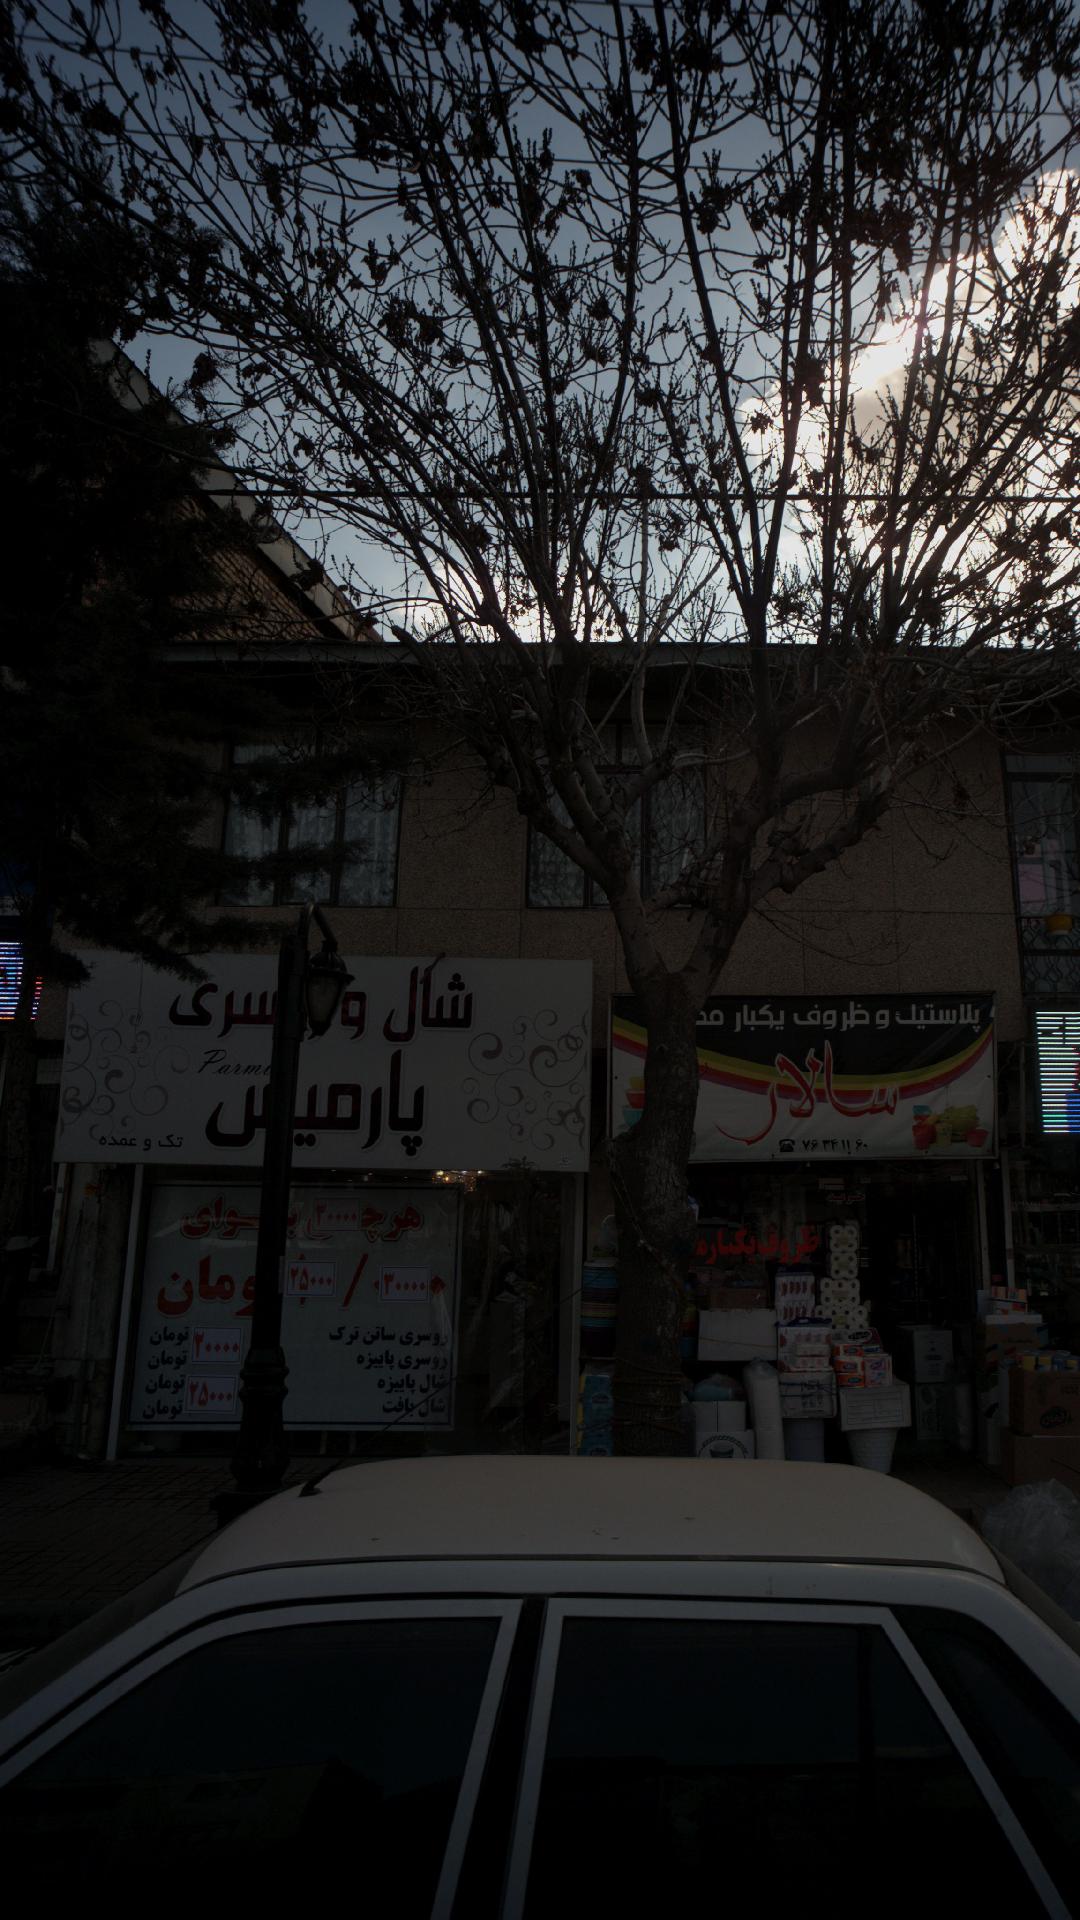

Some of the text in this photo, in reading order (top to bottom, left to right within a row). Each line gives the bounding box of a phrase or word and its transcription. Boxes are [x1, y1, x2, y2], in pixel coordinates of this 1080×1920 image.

[383, 966, 473, 1042] شال
[734, 1003, 785, 1033] یکبار
[793, 1000, 870, 1032] ظروف
[876, 1009, 890, 1030] و
[895, 1003, 980, 1033] پلاستیک
[714, 1040, 898, 1146] سالار
[99, 1134, 184, 1151] تک و عمده
[157, 1255, 257, 1316] ومان
[150, 1326, 190, 1346] تومان
[329, 1326, 359, 1345] ترک
[400, 1331, 448, 1346] روسری
[148, 1350, 188, 1370] تومان
[399, 1355, 448, 1370] روسری
[145, 1374, 185, 1394] تومان
[420, 1374, 447, 1393] شال
[142, 1399, 183, 1419] تومان
[382, 1396, 415, 1417] بافت
